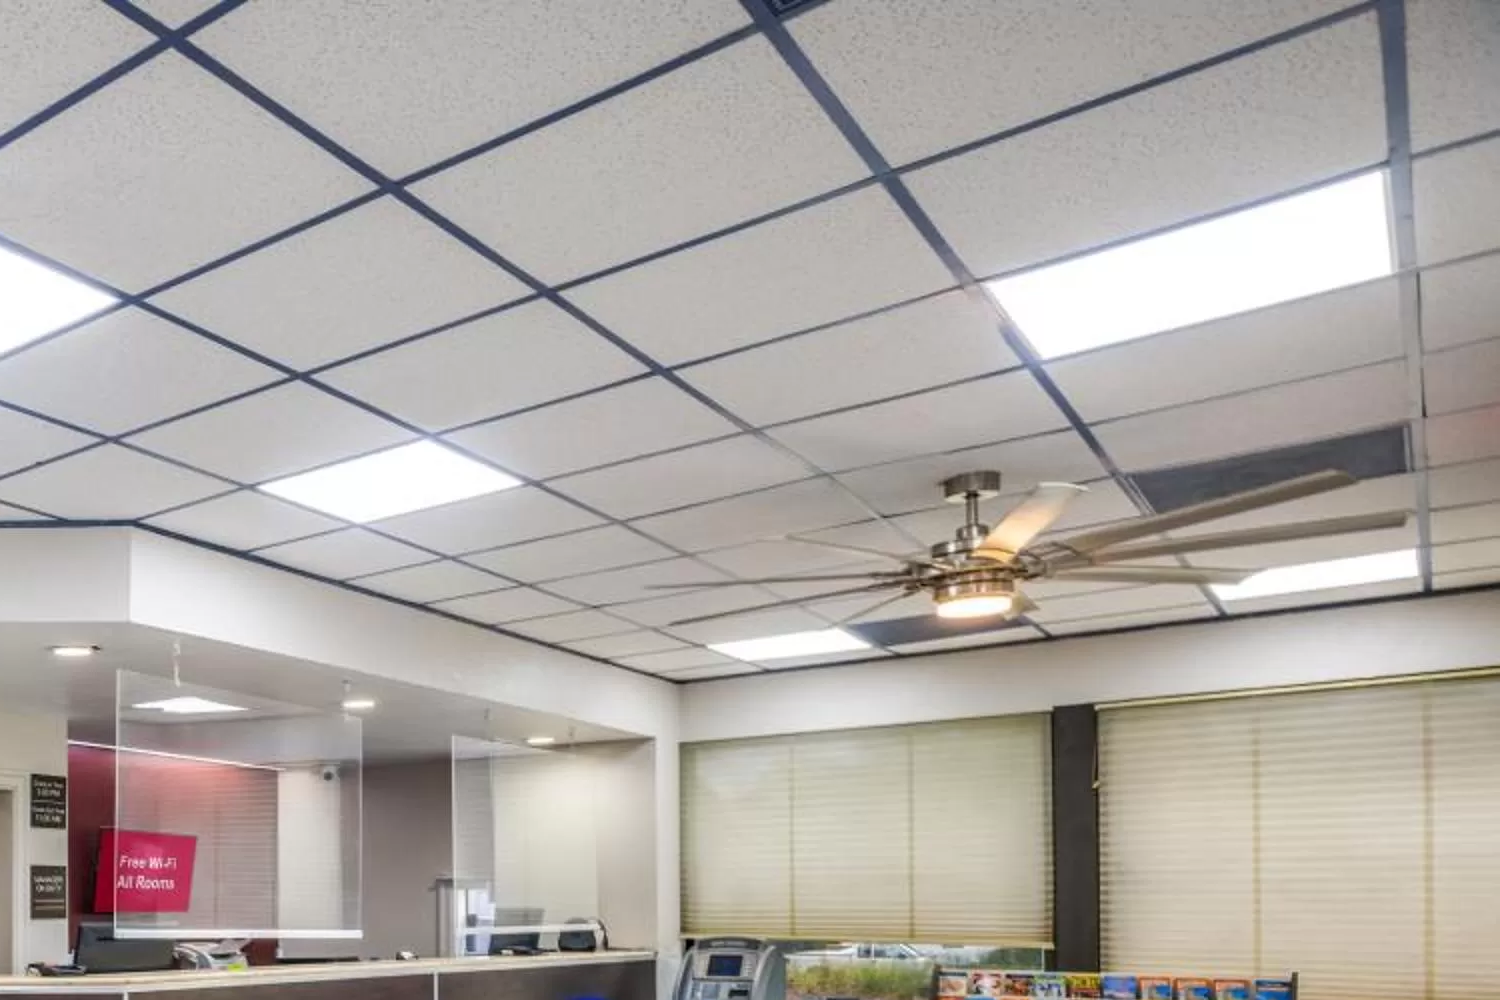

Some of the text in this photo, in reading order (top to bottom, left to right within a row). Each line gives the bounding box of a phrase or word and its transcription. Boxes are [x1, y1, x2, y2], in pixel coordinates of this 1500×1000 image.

[119, 855, 177, 870] Free Wi-Fi
[116, 875, 175, 890] All Rooms
